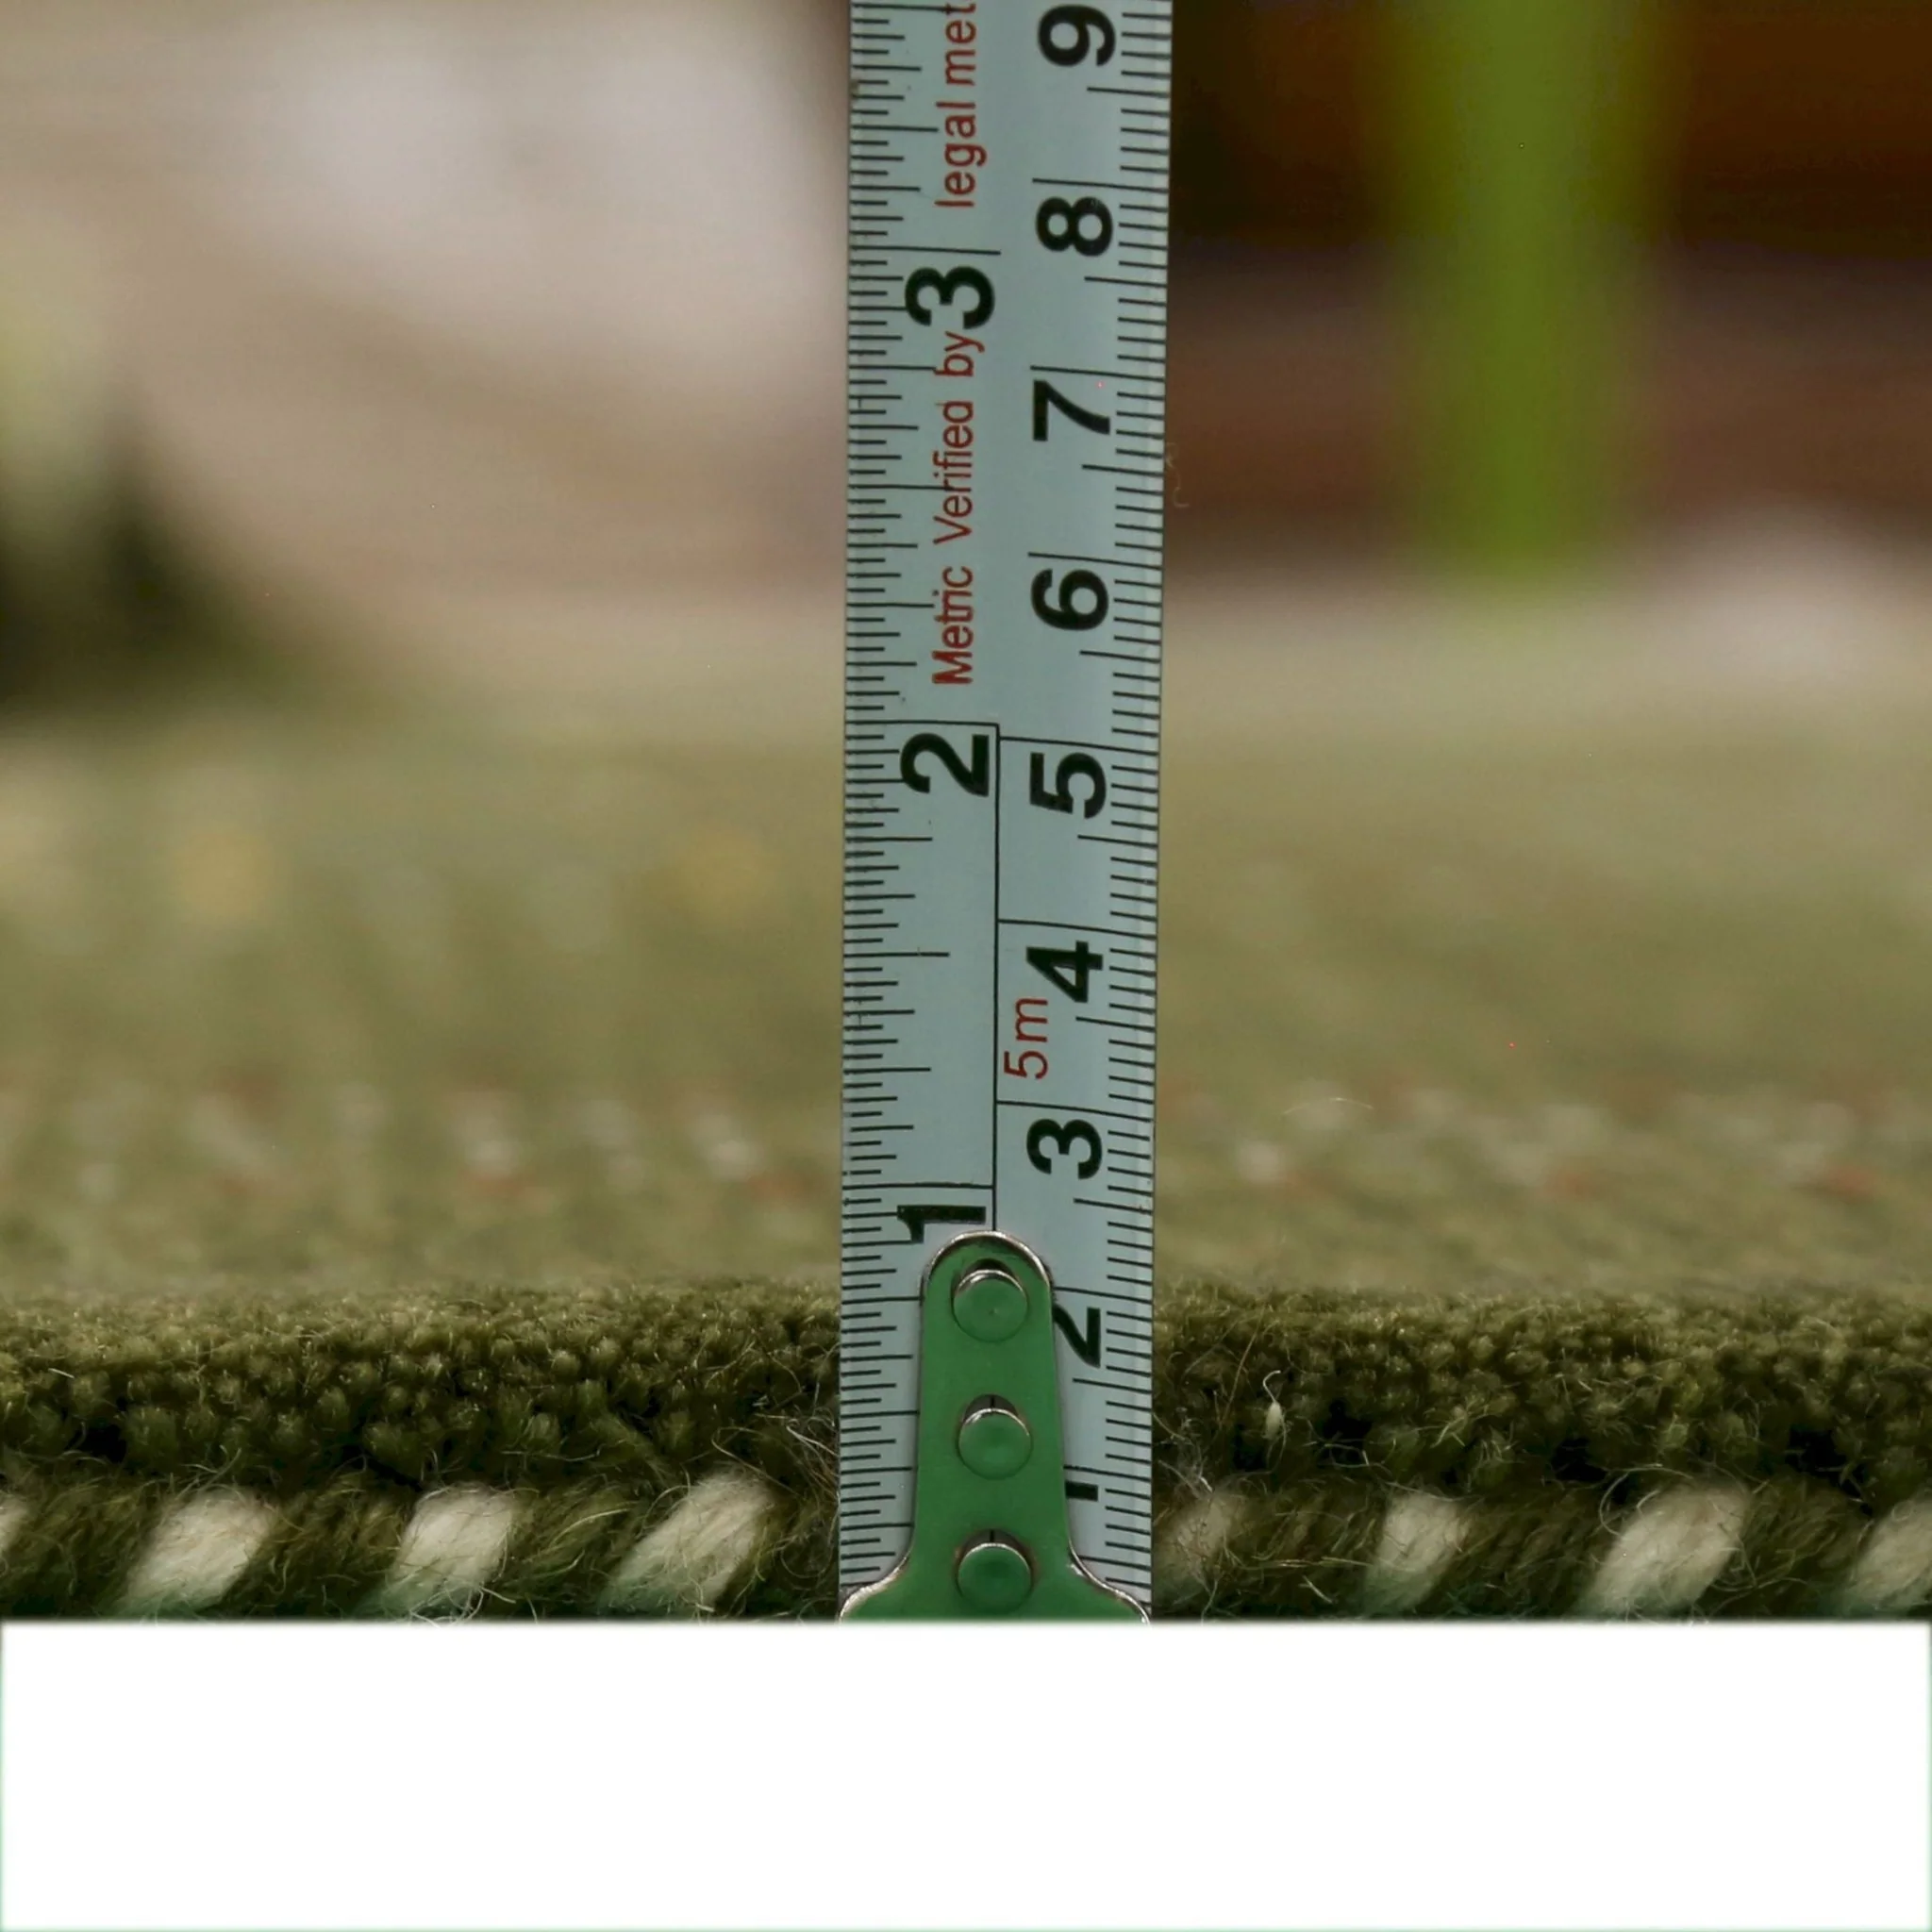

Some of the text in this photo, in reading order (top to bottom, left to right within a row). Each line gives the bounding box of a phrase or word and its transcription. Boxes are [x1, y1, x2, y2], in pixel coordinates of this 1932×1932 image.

[1039, 5, 1116, 67] 9
[934, 101, 987, 208] legal
[1036, 196, 1113, 257] 8
[905, 266, 995, 330] 3
[934, 331, 985, 377] by
[1033, 379, 1110, 441] 7
[933, 401, 974, 544] Verified
[931, 566, 974, 685] Metric
[1030, 568, 1109, 631] 6
[900, 732, 990, 797] 2
[1030, 752, 1107, 819] 5
[1026, 941, 1103, 1003] 4
[1004, 997, 1048, 1079] 5m
[1026, 1118, 1103, 1179] 3
[896, 1205, 987, 1243] 1
